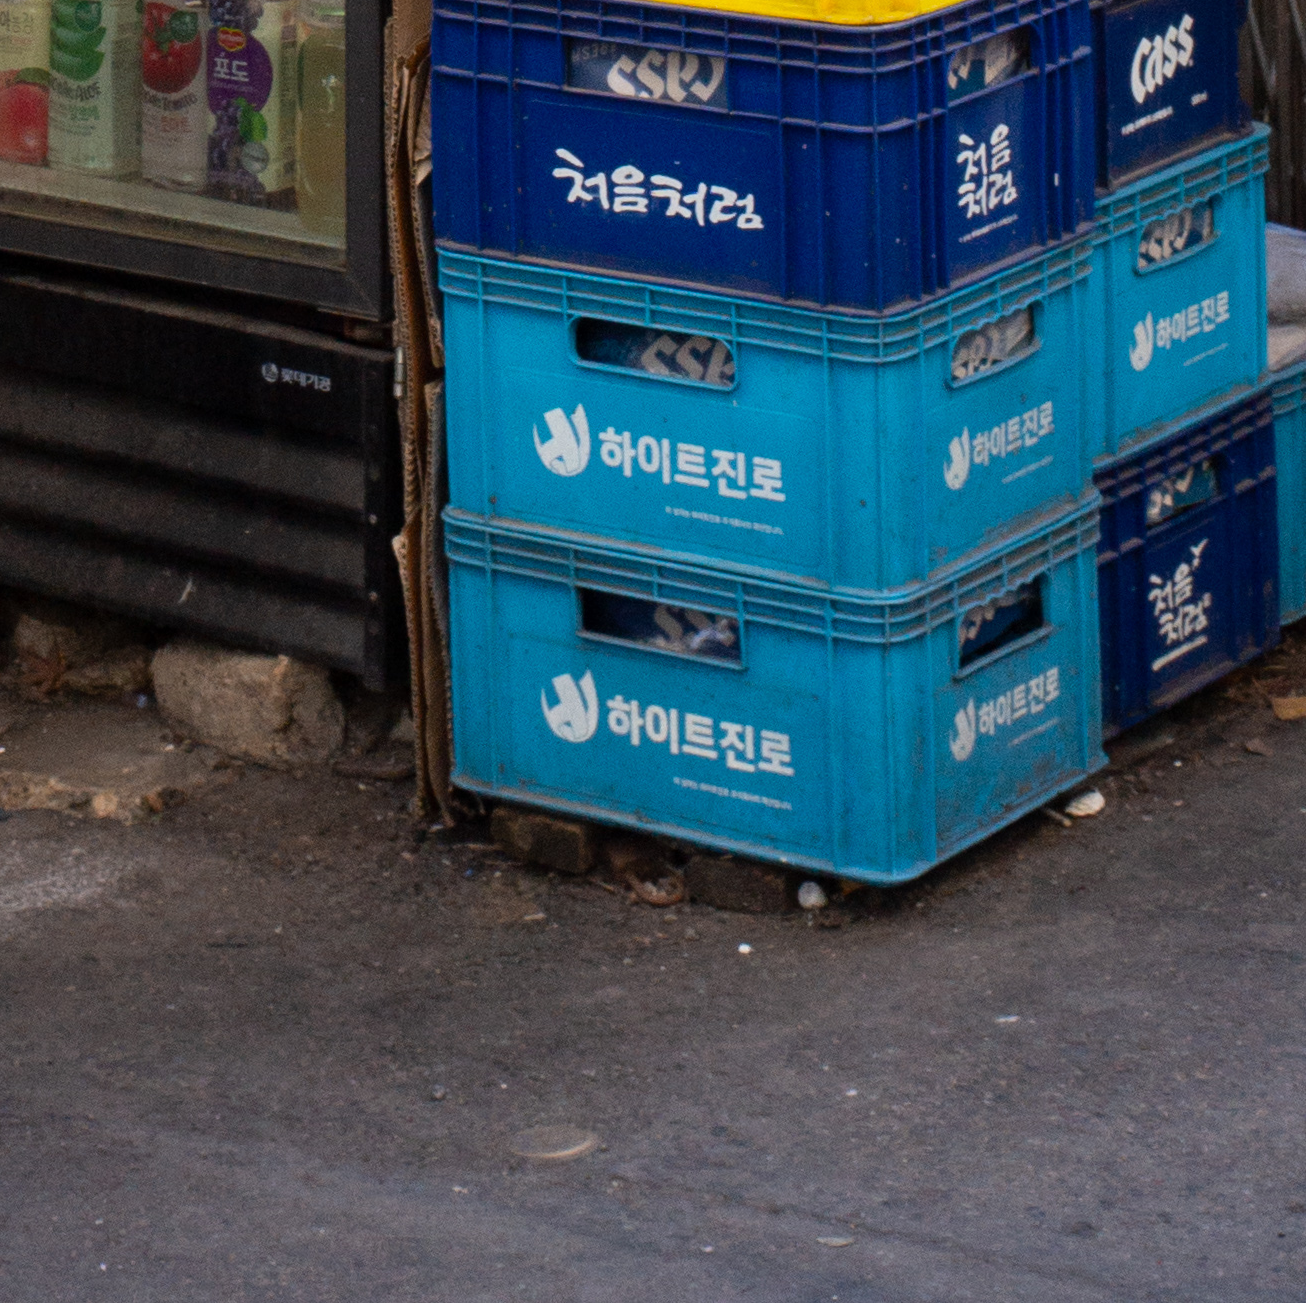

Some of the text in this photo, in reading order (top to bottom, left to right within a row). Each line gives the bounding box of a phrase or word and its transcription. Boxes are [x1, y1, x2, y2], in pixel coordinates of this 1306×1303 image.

[213, 56, 250, 83] 포도
[1131, 13, 1195, 105] Cass
[957, 123, 1011, 177] 처음
[552, 148, 765, 230] 처음처럼
[957, 170, 1019, 219] 처럼
[1155, 289, 1231, 350] 하이트진로
[598, 427, 786, 503] 하이트진로
[971, 400, 1055, 467] 하이트진로
[606, 694, 794, 777] 하이트진로
[977, 666, 1060, 737] 하이트진로
